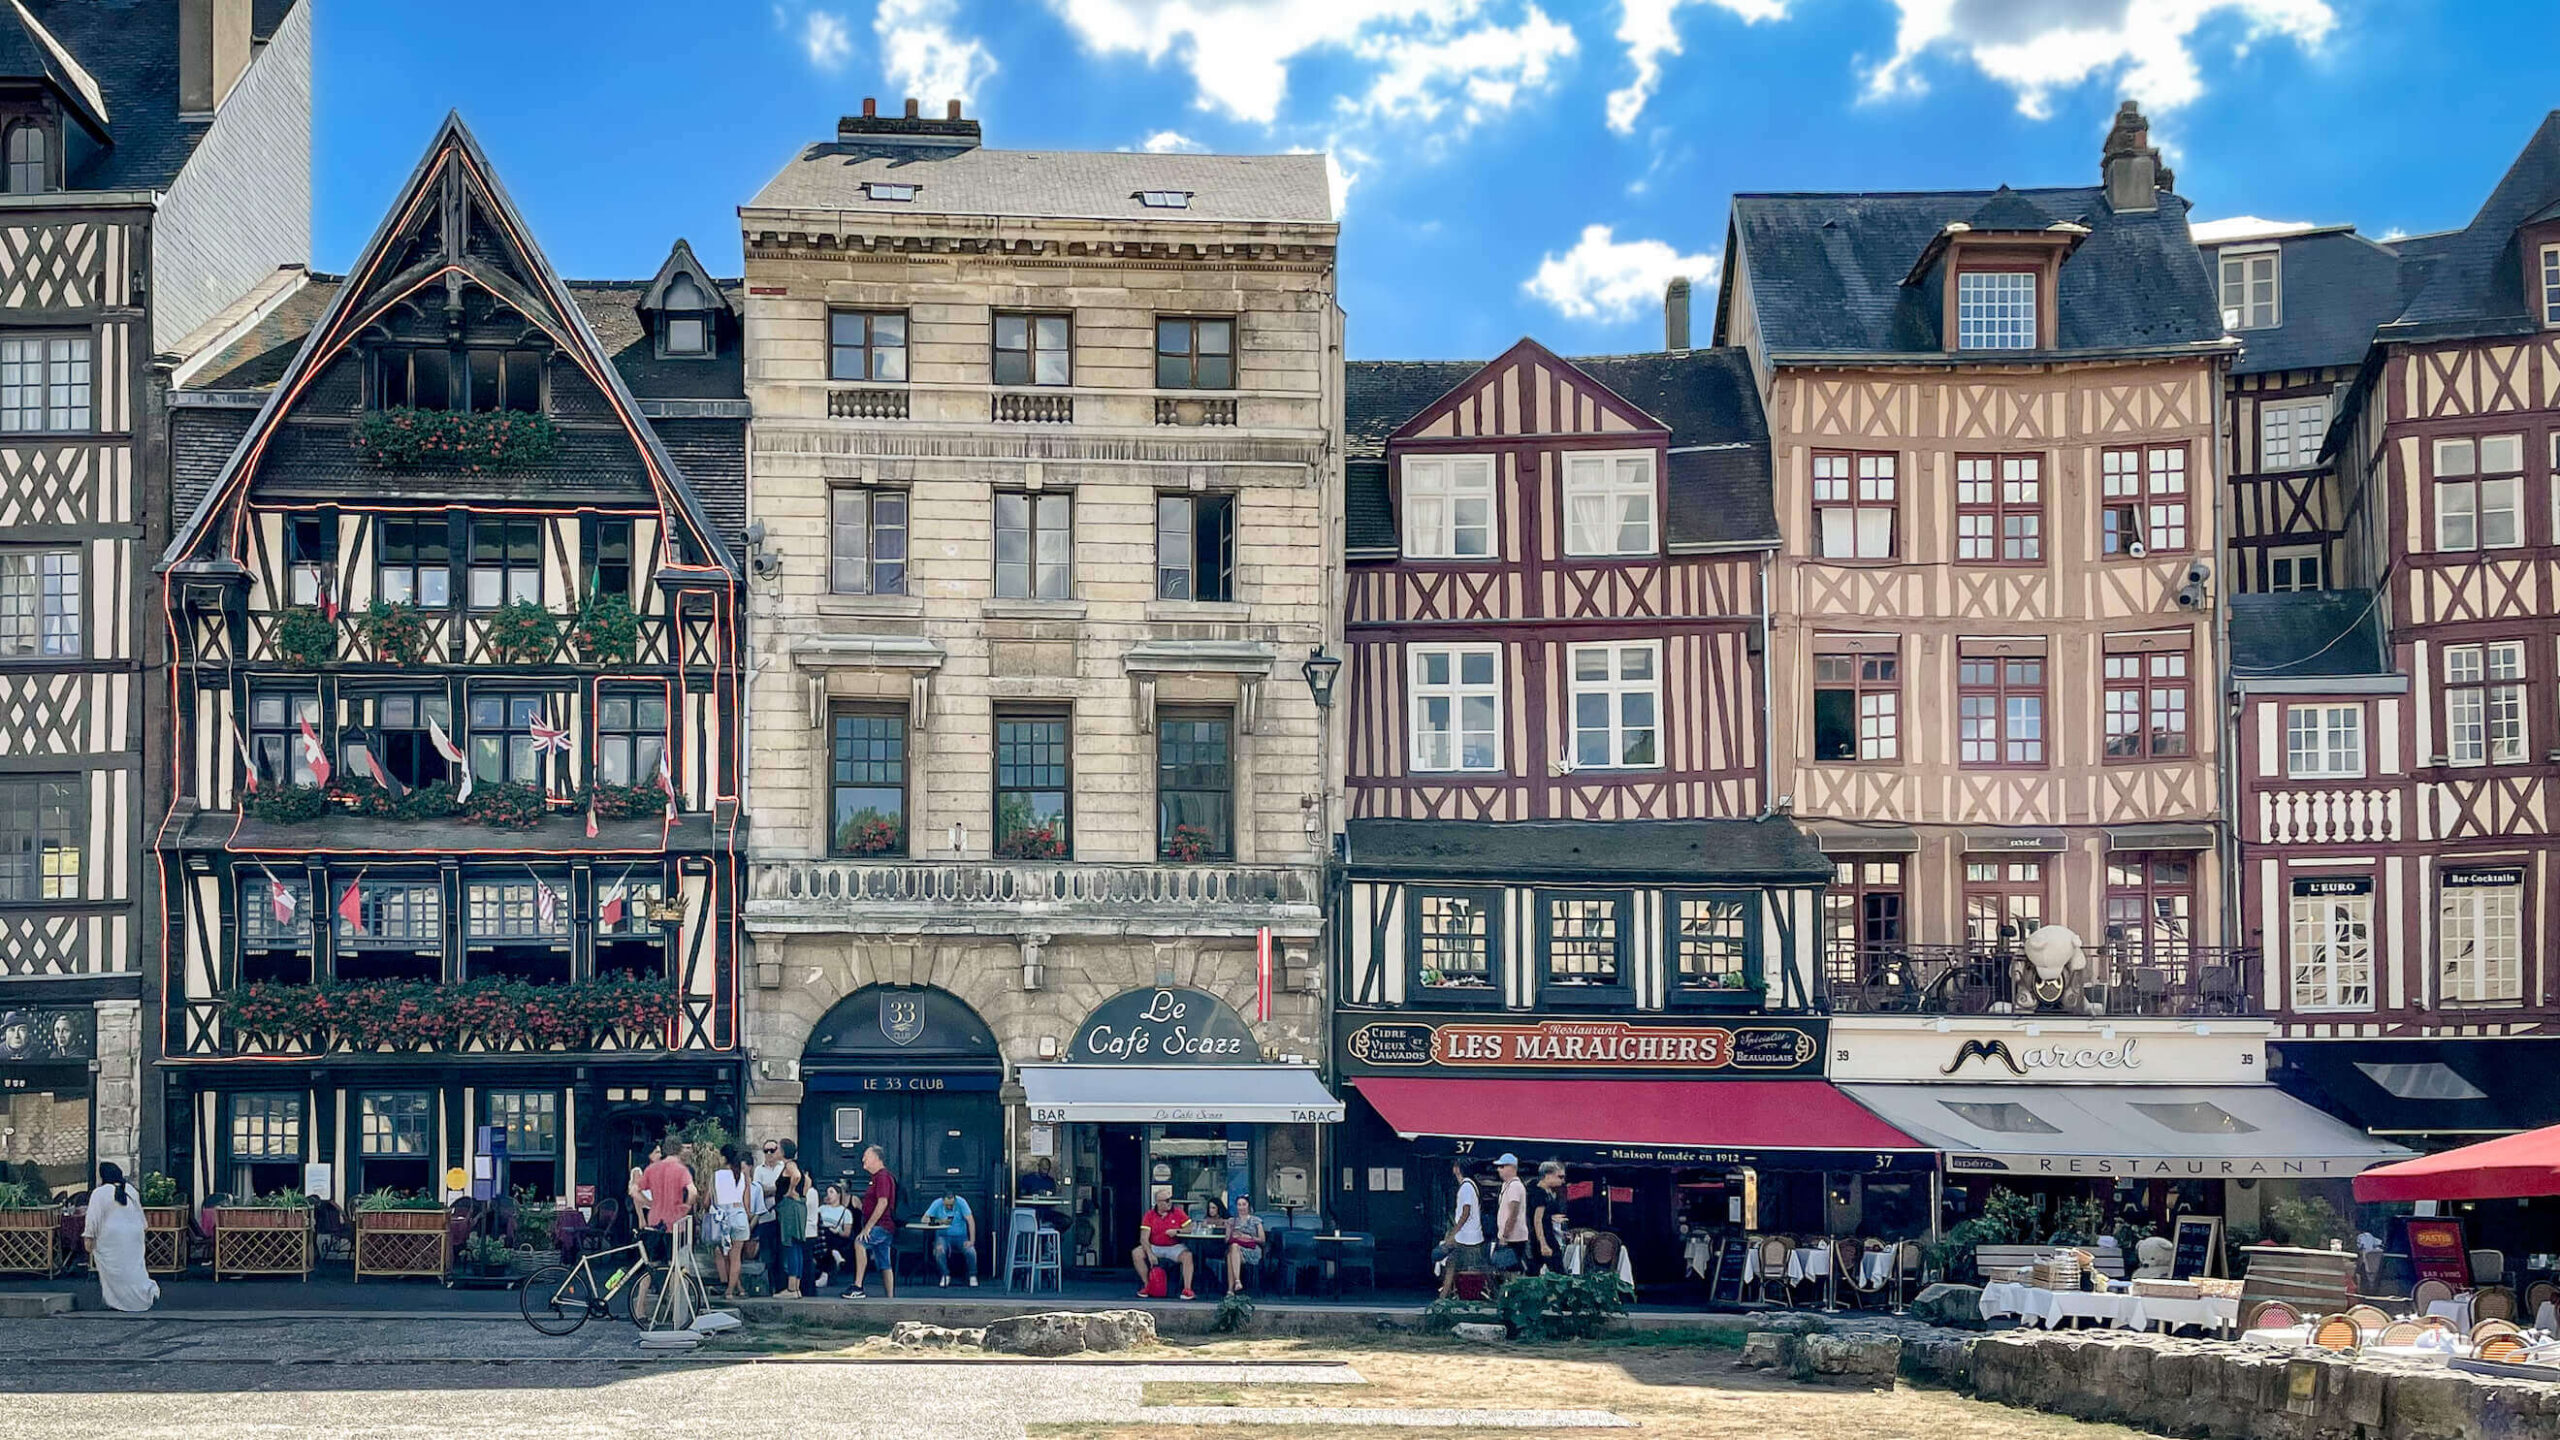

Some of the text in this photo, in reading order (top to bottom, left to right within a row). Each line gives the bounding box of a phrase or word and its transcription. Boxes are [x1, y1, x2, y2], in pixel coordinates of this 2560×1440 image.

[2452, 874, 2515, 883] Bar-Cocktails
[2310, 883, 2356, 892] L'EURO
[889, 1001, 917, 1023] 33
[1140, 991, 1187, 1023] Le
[1550, 1025, 1619, 1036] Restaurant
[1088, 1025, 1242, 1060] Café Scazz
[1448, 1033, 1719, 1062] LES MARAICHERS
[1837, 1050, 1849, 1061] 39
[1940, 1037, 2141, 1076] Marcel
[2240, 1053, 2254, 1065] 39
[863, 1077, 945, 1090] LE 33 CLUB
[1037, 1109, 1066, 1121] BAR
[1290, 1110, 1338, 1122] TABAC
[1455, 1140, 1475, 1154] 37
[1611, 1149, 1740, 1163] Maison fondée en 1912
[1875, 1154, 1894, 1169] 37
[2039, 1158, 2330, 1174] RESTAURANT
